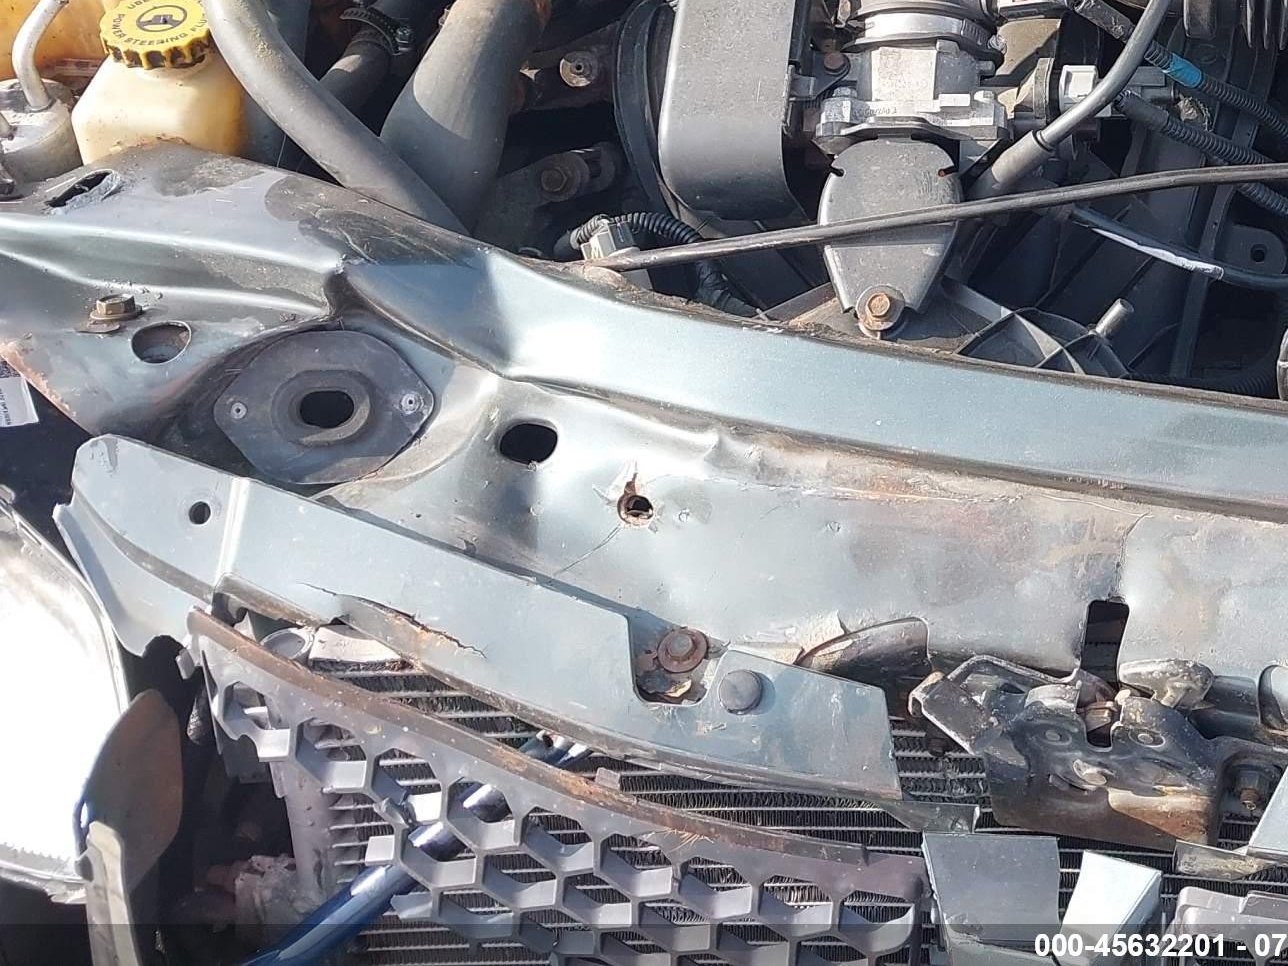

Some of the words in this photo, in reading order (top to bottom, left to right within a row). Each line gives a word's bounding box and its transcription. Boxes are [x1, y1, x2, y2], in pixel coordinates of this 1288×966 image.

[111, 13, 126, 39] POWER
[123, 32, 188, 46] STEERING
[189, 12, 208, 32] FLU
